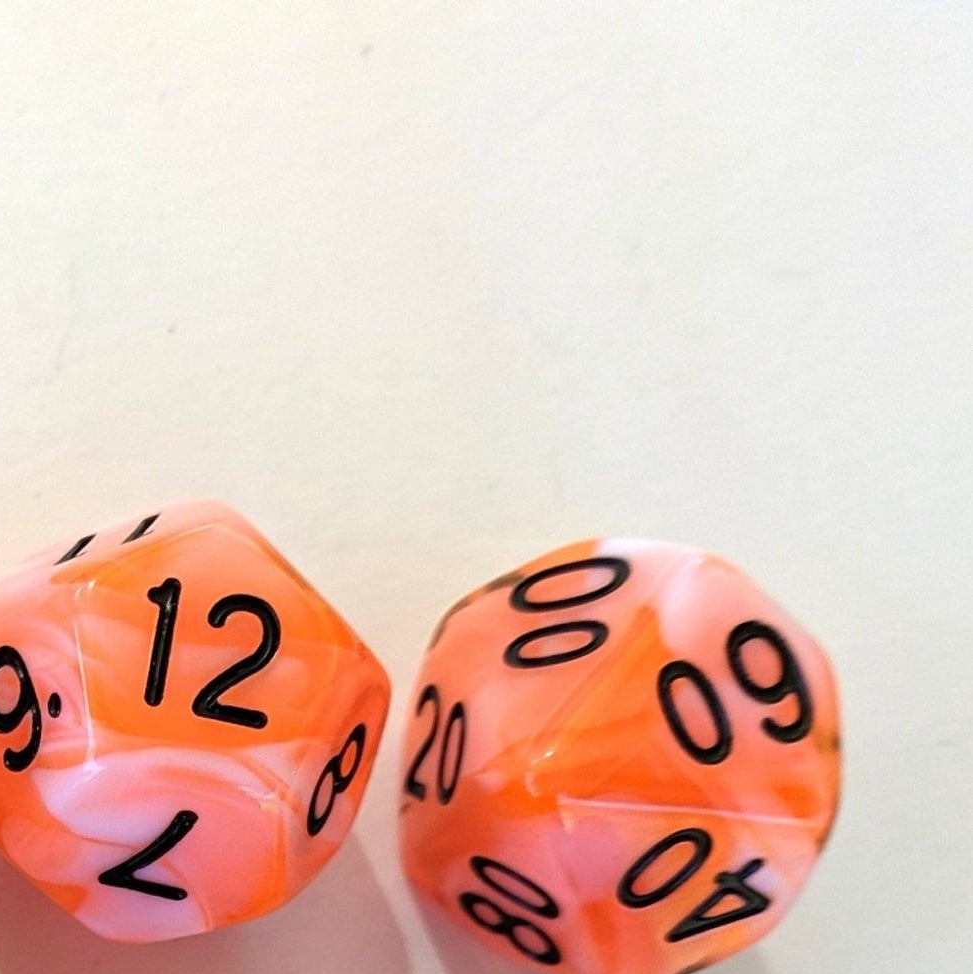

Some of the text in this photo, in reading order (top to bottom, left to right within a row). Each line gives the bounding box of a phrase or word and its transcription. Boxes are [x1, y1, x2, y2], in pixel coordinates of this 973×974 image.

[142, 576, 283, 730] 12
[501, 556, 631, 670] 00
[305, 722, 367, 838] 8
[403, 684, 468, 806] 20
[96, 809, 200, 902] 7
[457, 854, 562, 967] 80
[616, 826, 772, 944] 40
